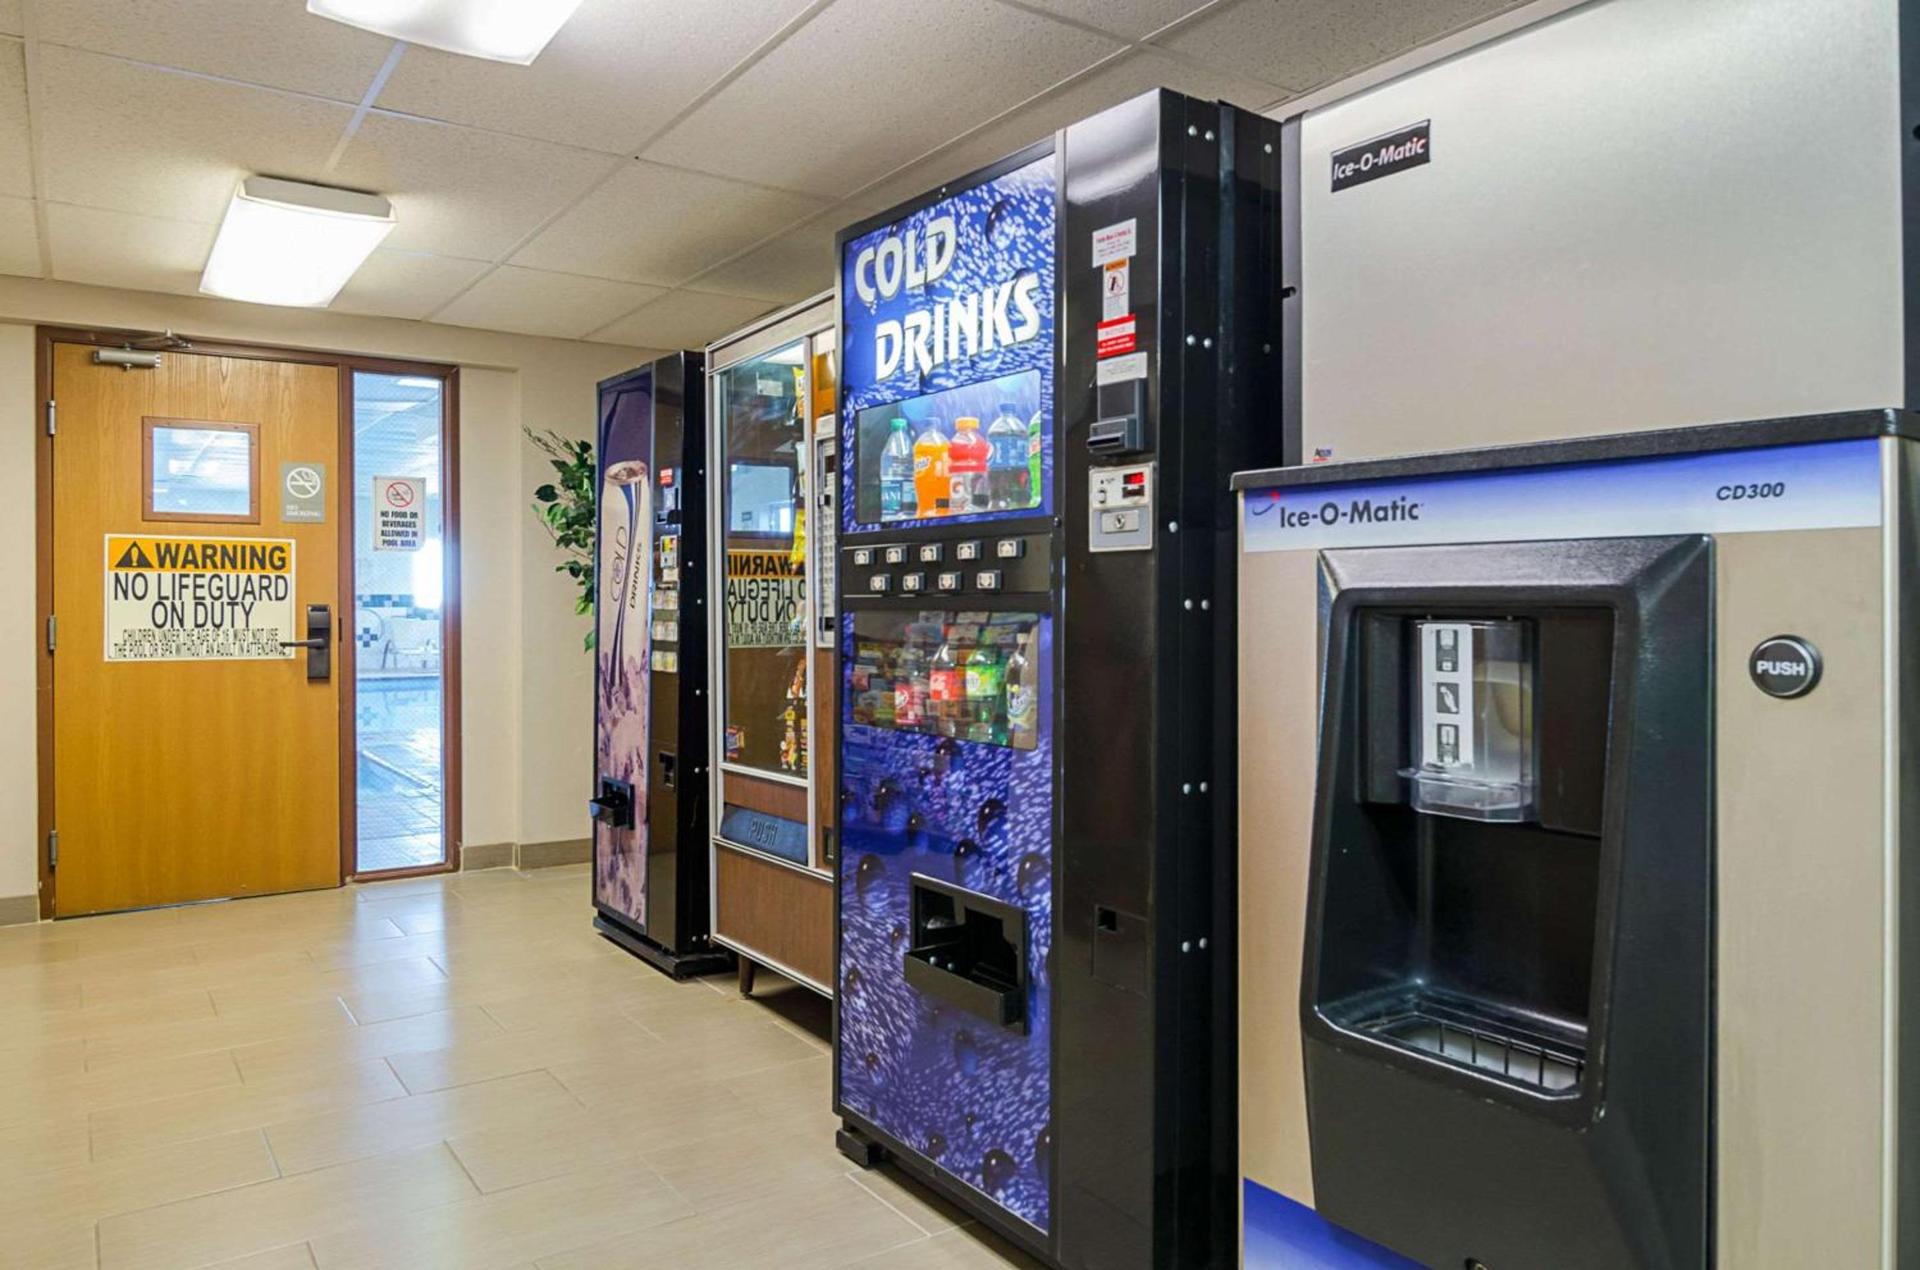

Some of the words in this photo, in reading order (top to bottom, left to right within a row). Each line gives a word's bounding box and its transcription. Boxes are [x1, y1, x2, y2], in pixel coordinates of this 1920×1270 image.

[1333, 137, 1426, 180] Ice-O-Matic
[855, 216, 956, 302] COLD
[876, 273, 1041, 381] DRINKS
[1716, 482, 1785, 501] CD300
[380, 510, 389, 518] NO
[391, 510, 407, 518] FOOD
[1280, 496, 1419, 528] Ice-O-Matic
[155, 543, 286, 570] WARNING
[114, 572, 148, 600] NO
[157, 572, 288, 601] LIFEGUARD
[630, 543, 642, 609] DRINKS
[151, 601, 185, 629] ON
[194, 601, 255, 629] DUTY
[1756, 660, 1806, 676] PUSH
[751, 820, 778, 848] PUSH
